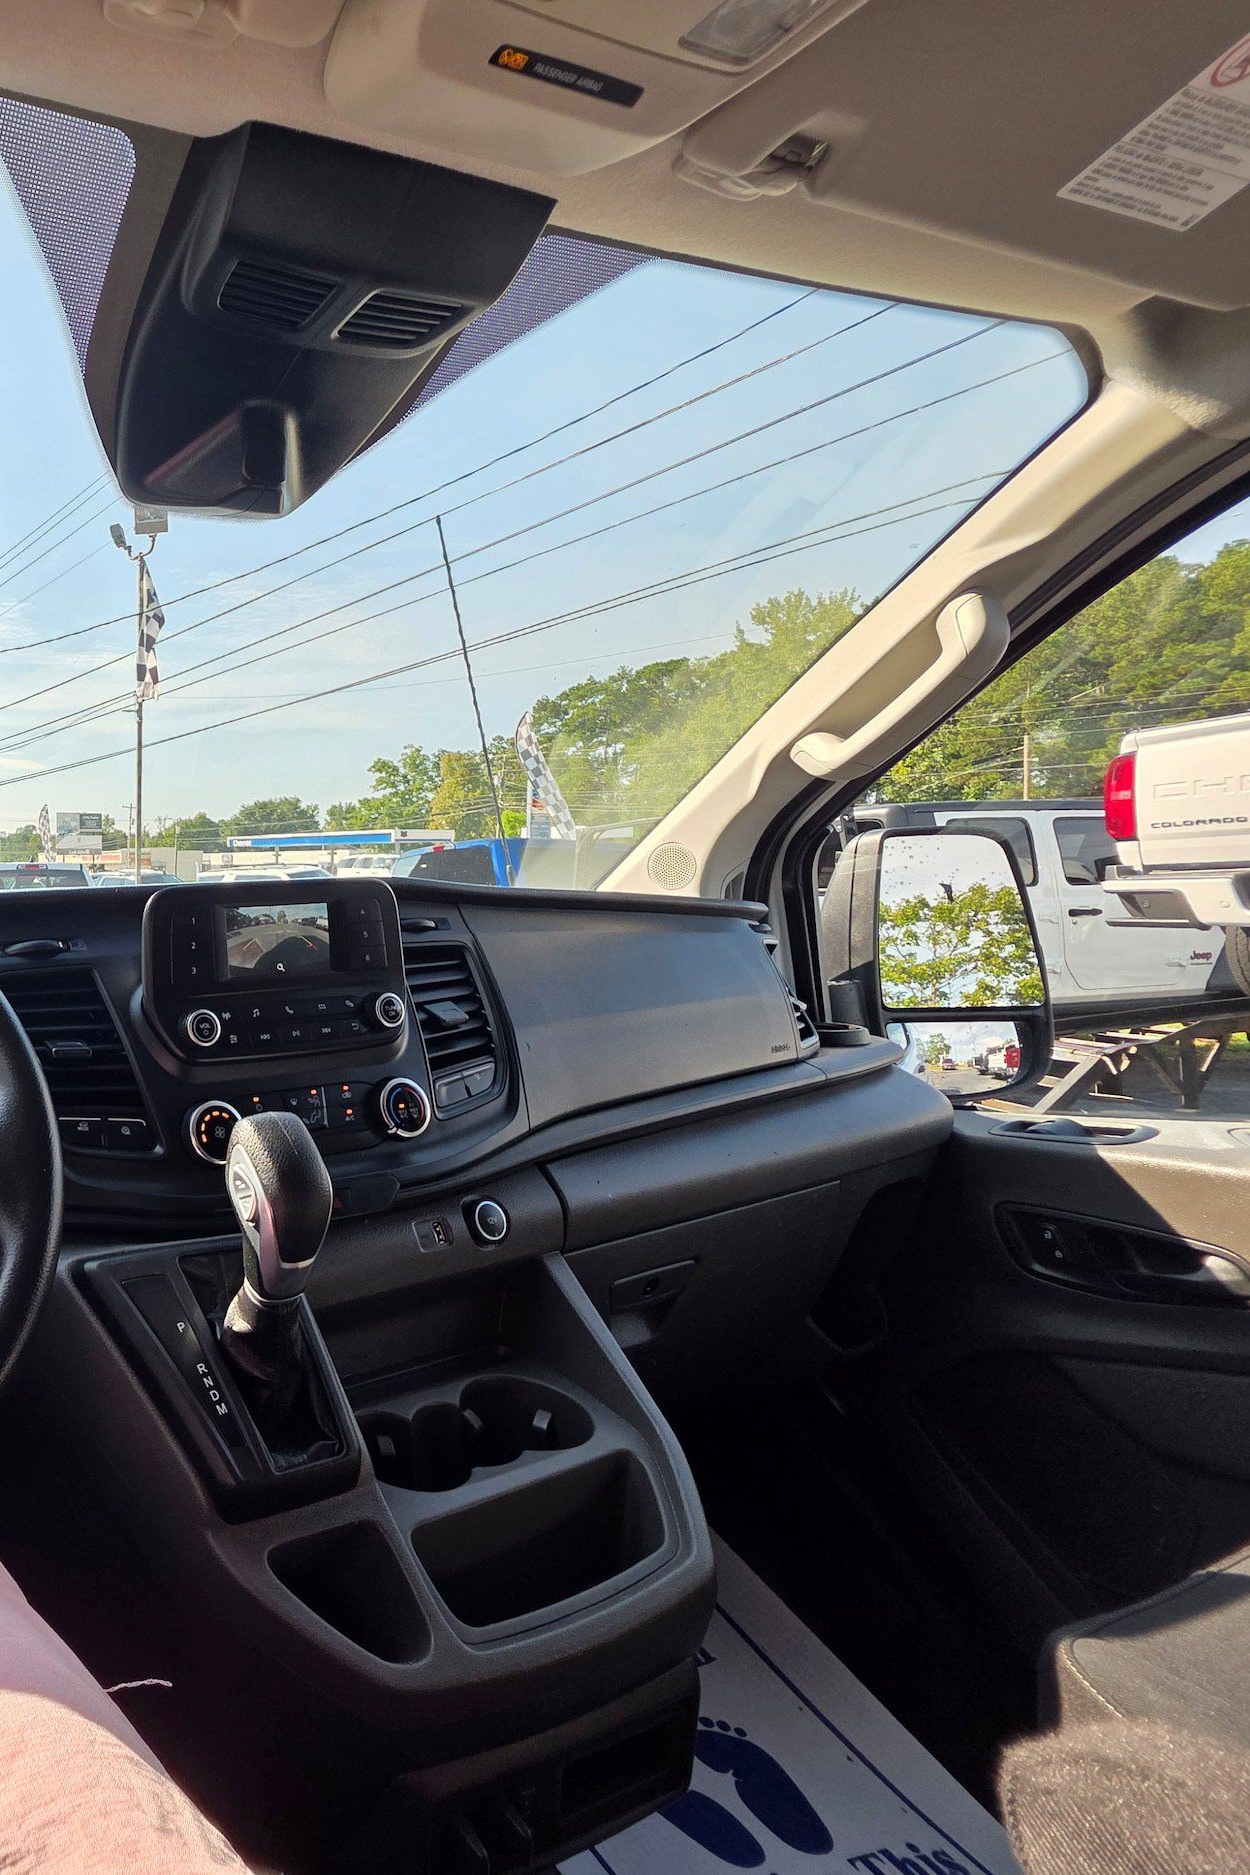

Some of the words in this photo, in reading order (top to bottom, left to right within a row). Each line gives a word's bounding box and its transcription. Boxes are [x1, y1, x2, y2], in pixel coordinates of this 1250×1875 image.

[533, 63, 577, 83] PASSENGER
[575, 77, 604, 91] AIRBAG
[1151, 816, 1248, 829] COLORADO
[1190, 950, 1213, 961] Jeep
[176, 1321, 186, 1333] P
[196, 1363, 208, 1374] R
[202, 1376, 214, 1388] N
[209, 1390, 220, 1401] D
[216, 1402, 229, 1415] M
